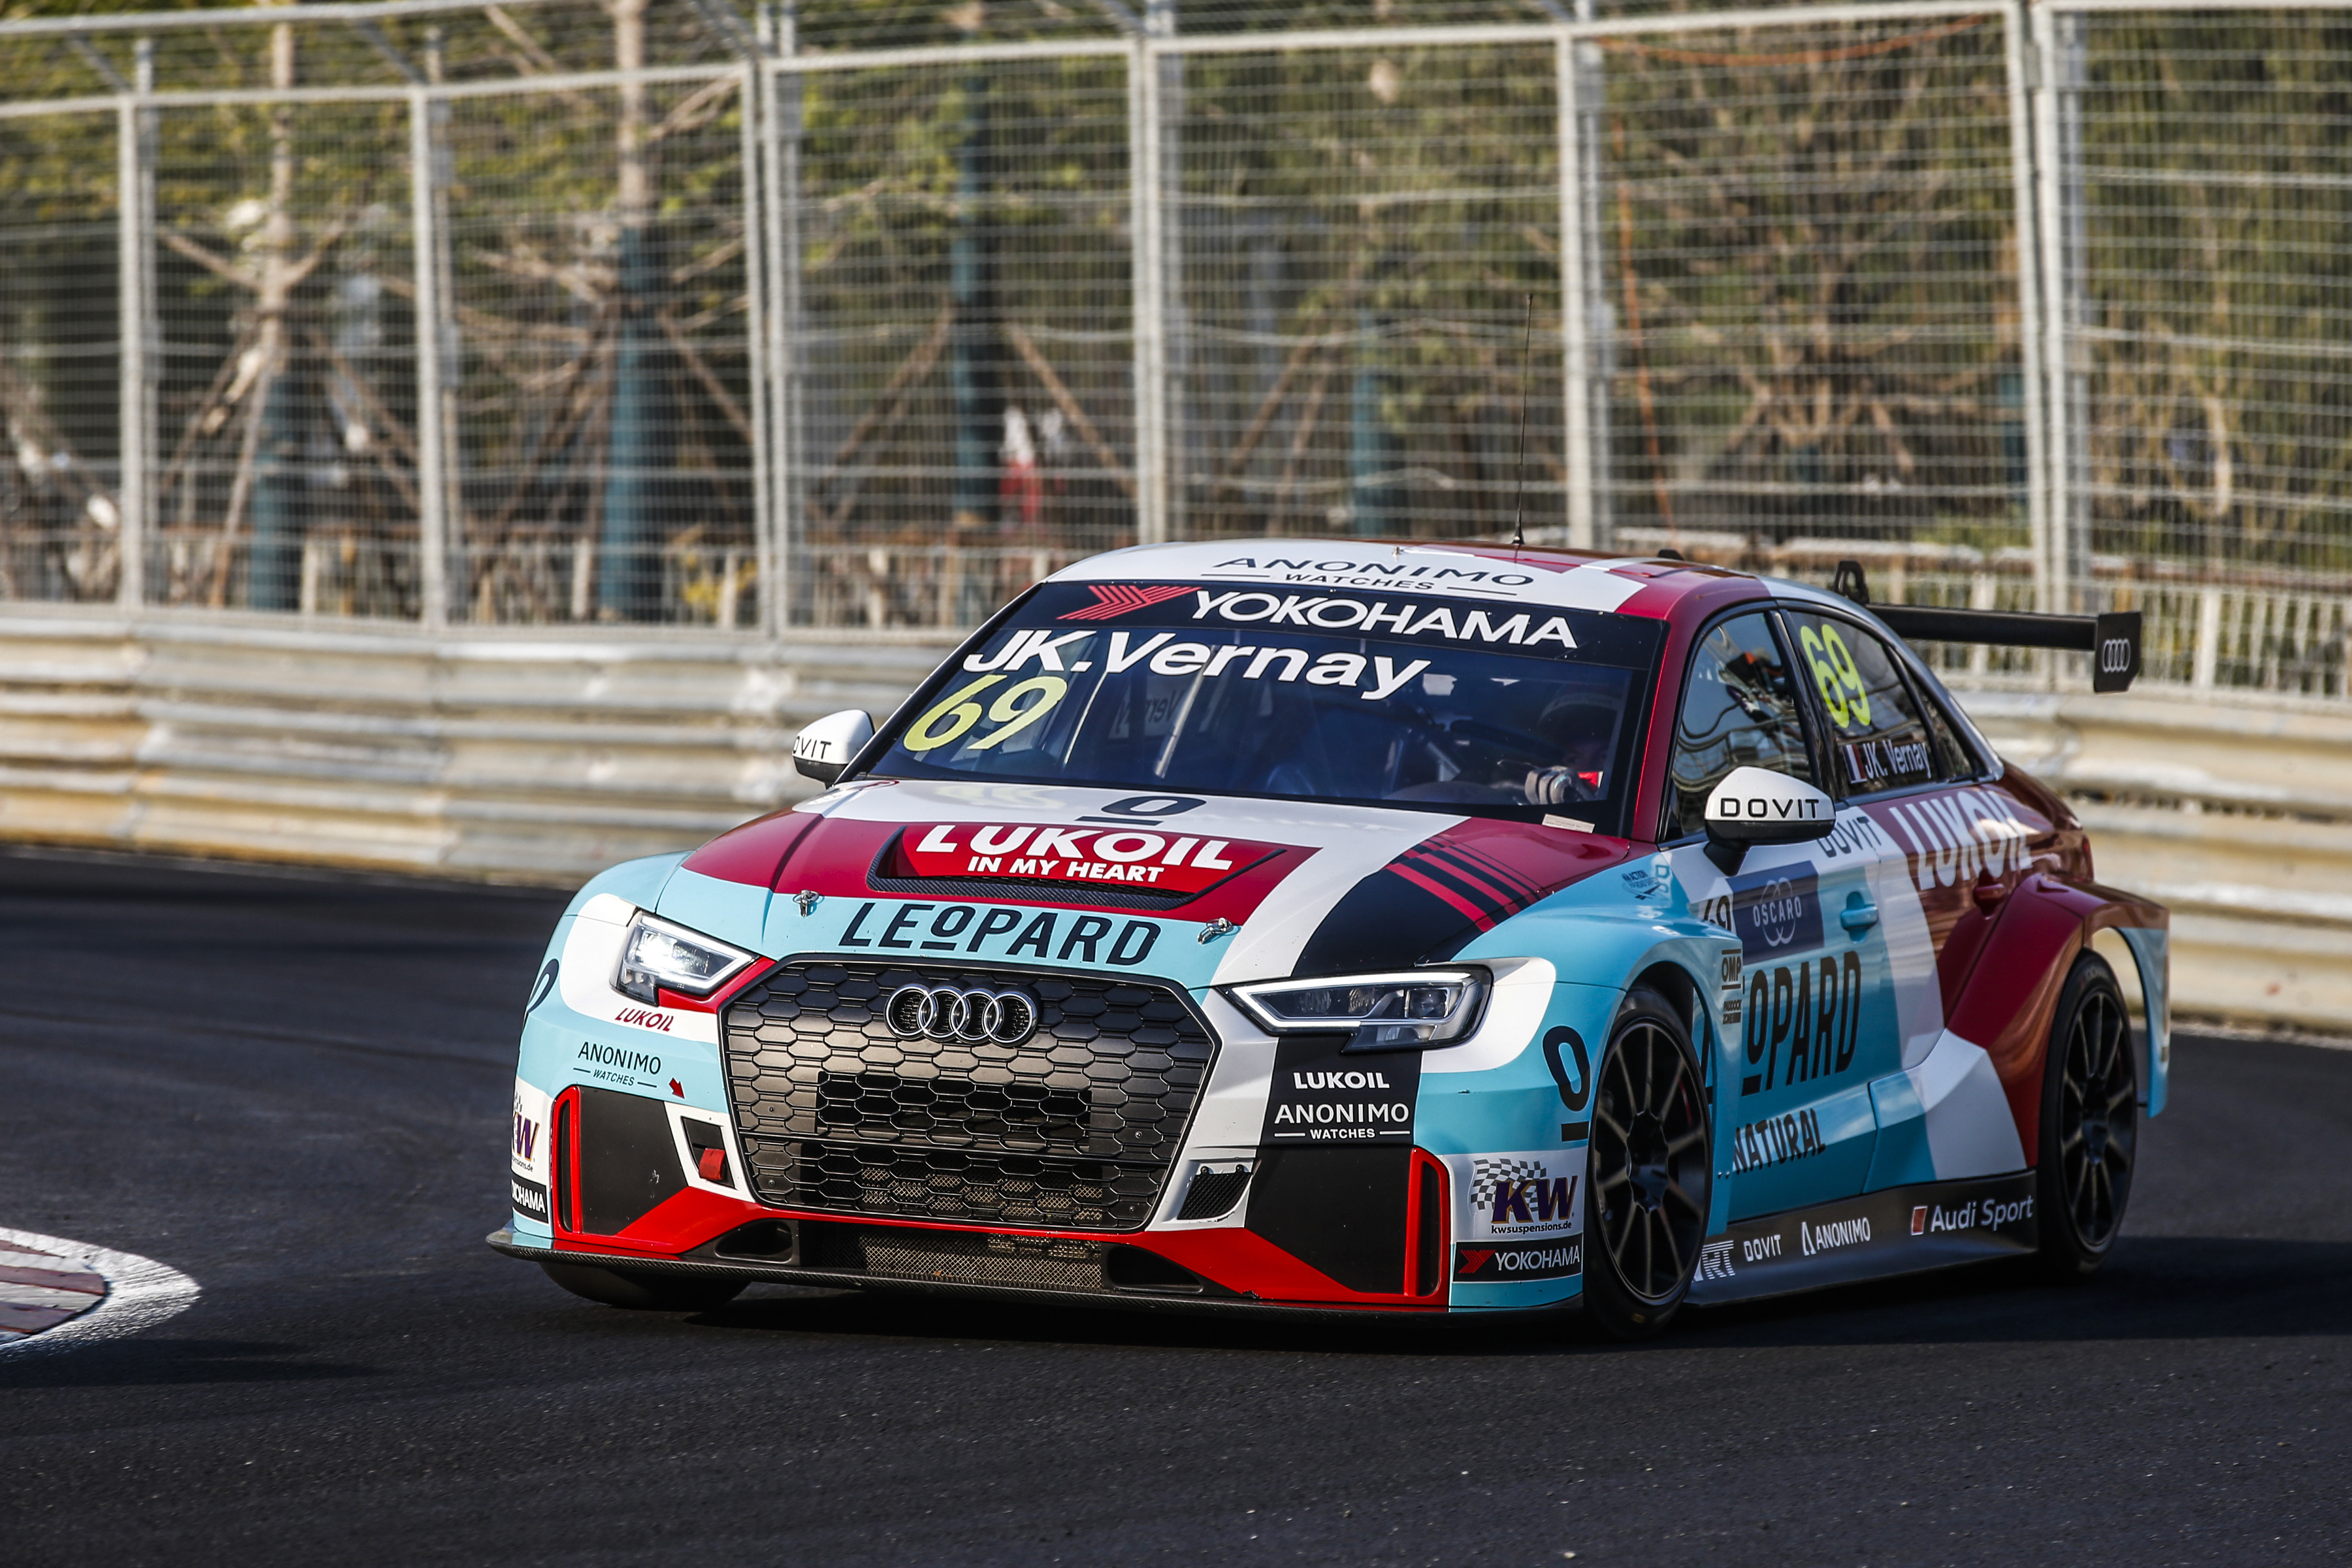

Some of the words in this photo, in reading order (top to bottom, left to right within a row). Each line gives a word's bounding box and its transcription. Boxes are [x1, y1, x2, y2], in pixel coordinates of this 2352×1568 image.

[1213, 557, 1534, 587] ANONIMO
[1285, 573, 1435, 591] WATCHES
[1192, 590, 1577, 649] YOKOHAMA
[1801, 624, 1871, 729] 69
[903, 674, 1068, 752] 69
[793, 735, 832, 759] OVIT
[1864, 744, 1888, 781] JK.
[1882, 740, 1932, 780] Vernay
[1721, 798, 1820, 819] DOVIT
[916, 824, 1233, 871] LUKOIL
[1817, 816, 1882, 858] DOVIT
[1889, 791, 2033, 891] LUKOIL
[967, 856, 991, 873] IN
[1021, 859, 1058, 878] MY
[1066, 861, 1165, 883] HEART
[1753, 896, 1802, 928] OSCARO
[1722, 956, 1742, 982] OMP
[615, 1008, 674, 1032] LUKOIL
[577, 1041, 661, 1076] ANONIMO
[593, 1068, 635, 1086] WATCHES
[1293, 1071, 1390, 1090] LUKOIL
[1274, 1102, 1410, 1124] ANONIMO
[1310, 1128, 1376, 1140] WATCHES
[1733, 1109, 1826, 1175] NATURAL
[1491, 1174, 1578, 1224] KW
[1931, 1203, 1976, 1233] Audi
[1980, 1195, 2034, 1231] Sport
[1491, 1220, 1572, 1235] kwsuspensions.de
[1744, 1234, 1781, 1262] DOVIT
[1816, 1217, 1871, 1251] ANONIMO
[1495, 1245, 1580, 1272] YOKOHAMA
